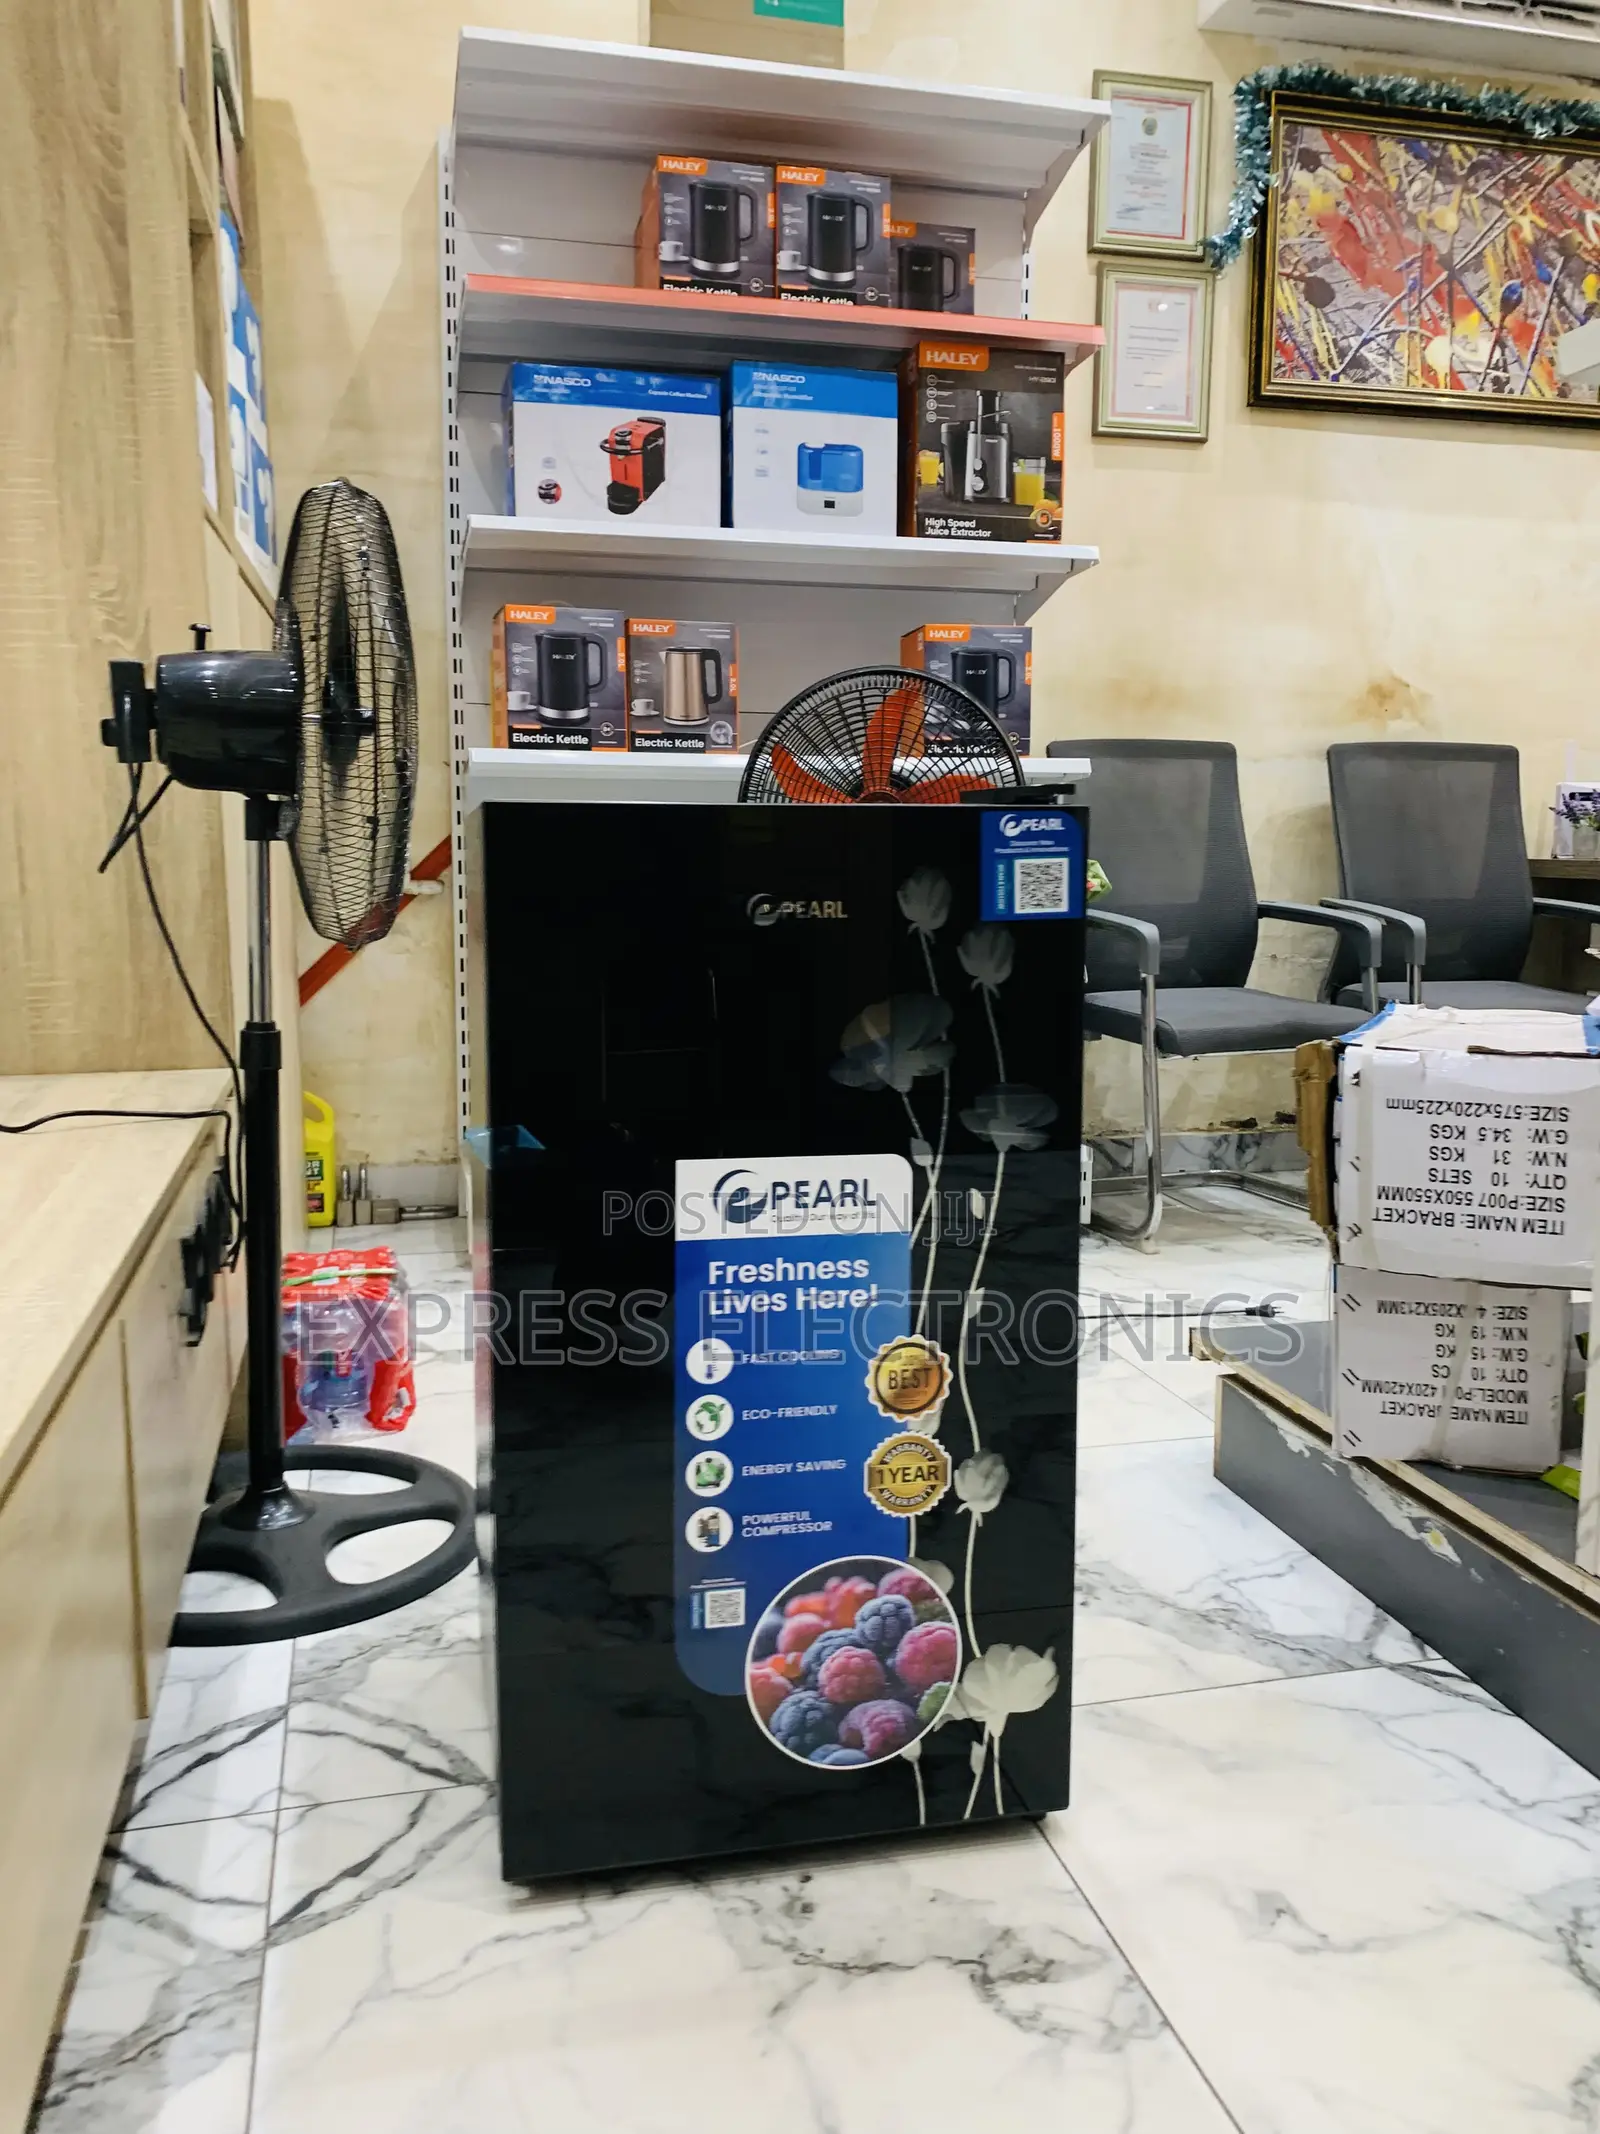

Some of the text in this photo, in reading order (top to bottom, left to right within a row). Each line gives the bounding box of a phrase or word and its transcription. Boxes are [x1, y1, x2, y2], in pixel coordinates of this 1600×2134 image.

[663, 160, 701, 171] HALEY
[781, 170, 820, 182] HALEY
[926, 351, 980, 365] HALEY
[1052, 428, 1061, 457] 1000W
[925, 518, 976, 529] High Speed
[925, 527, 991, 538] Juice Extractor
[510, 610, 550, 620] HALEY
[633, 624, 671, 633] HALEY
[929, 630, 965, 639] HALEY
[512, 733, 589, 745] Electric Kettle
[635, 738, 705, 748] Electric Kettle
[1021, 818, 1066, 831] PEARL
[781, 900, 848, 918] PEARL
[1386, 1098, 1569, 1122] SIZE:575x220x225mm
[1430, 1124, 1466, 1140] KGS
[1478, 1127, 1511, 1143] 34.5
[1429, 1146, 1465, 1162] KGS
[1493, 1150, 1511, 1165] 31
[1429, 1168, 1566, 1190] QTY: 10 SETS
[772, 1178, 876, 1210] PEARL
[1377, 1185, 1473, 1205] 550X550MM
[1372, 1207, 1565, 1235] ITEM NAME: BRACKET
[709, 1257, 869, 1285] Freshness
[709, 1284, 878, 1315] Lives Here!
[1492, 1305, 1528, 1320] SIZE:
[1435, 1323, 1455, 1338] KG
[1471, 1325, 1487, 1340] 19
[743, 1351, 776, 1364] FAST
[1435, 1344, 1456, 1358] KG
[1471, 1346, 1487, 1361] 15
[889, 1368, 932, 1389] BEST
[1431, 1364, 1528, 1384] QTY: 10 CS
[1362, 1379, 1437, 1398] 420X420MM
[742, 1405, 838, 1420] ECO-FRIENDLY
[1494, 1407, 1528, 1425] ITEM
[881, 1443, 934, 1462] WARRANTY
[742, 1459, 847, 1476] ENERGY SAVING
[876, 1465, 939, 1484] 1 YEAR
[742, 1511, 812, 1525] POWERFUL
[742, 1521, 833, 1538] COMPRESSOR
